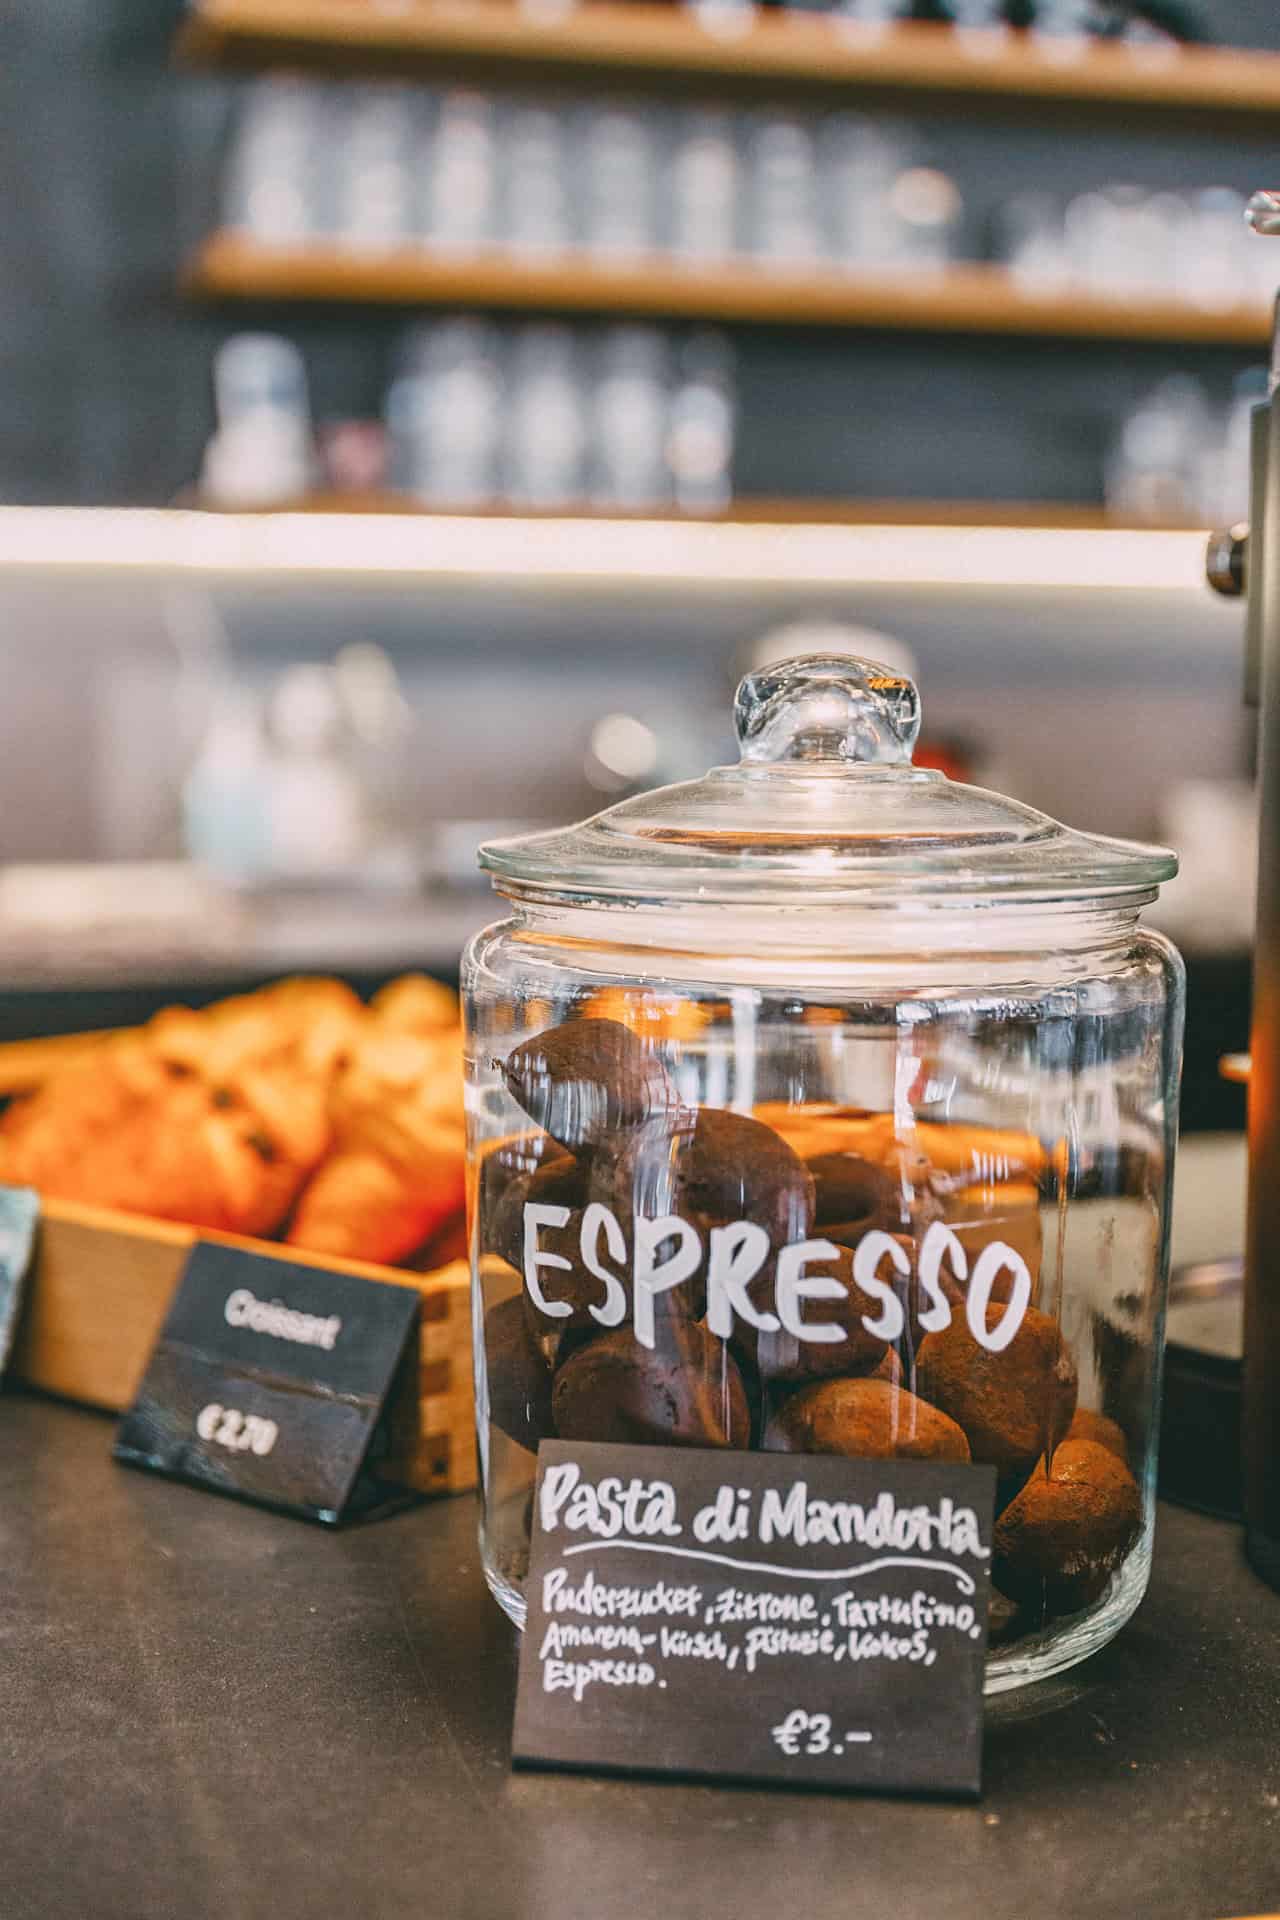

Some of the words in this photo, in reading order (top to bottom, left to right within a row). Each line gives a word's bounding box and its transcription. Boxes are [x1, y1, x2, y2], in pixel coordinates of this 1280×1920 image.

[523, 1201, 1031, 1352] ESPRESSO
[539, 1462, 683, 1538] Pasta
[693, 1486, 752, 1543] di
